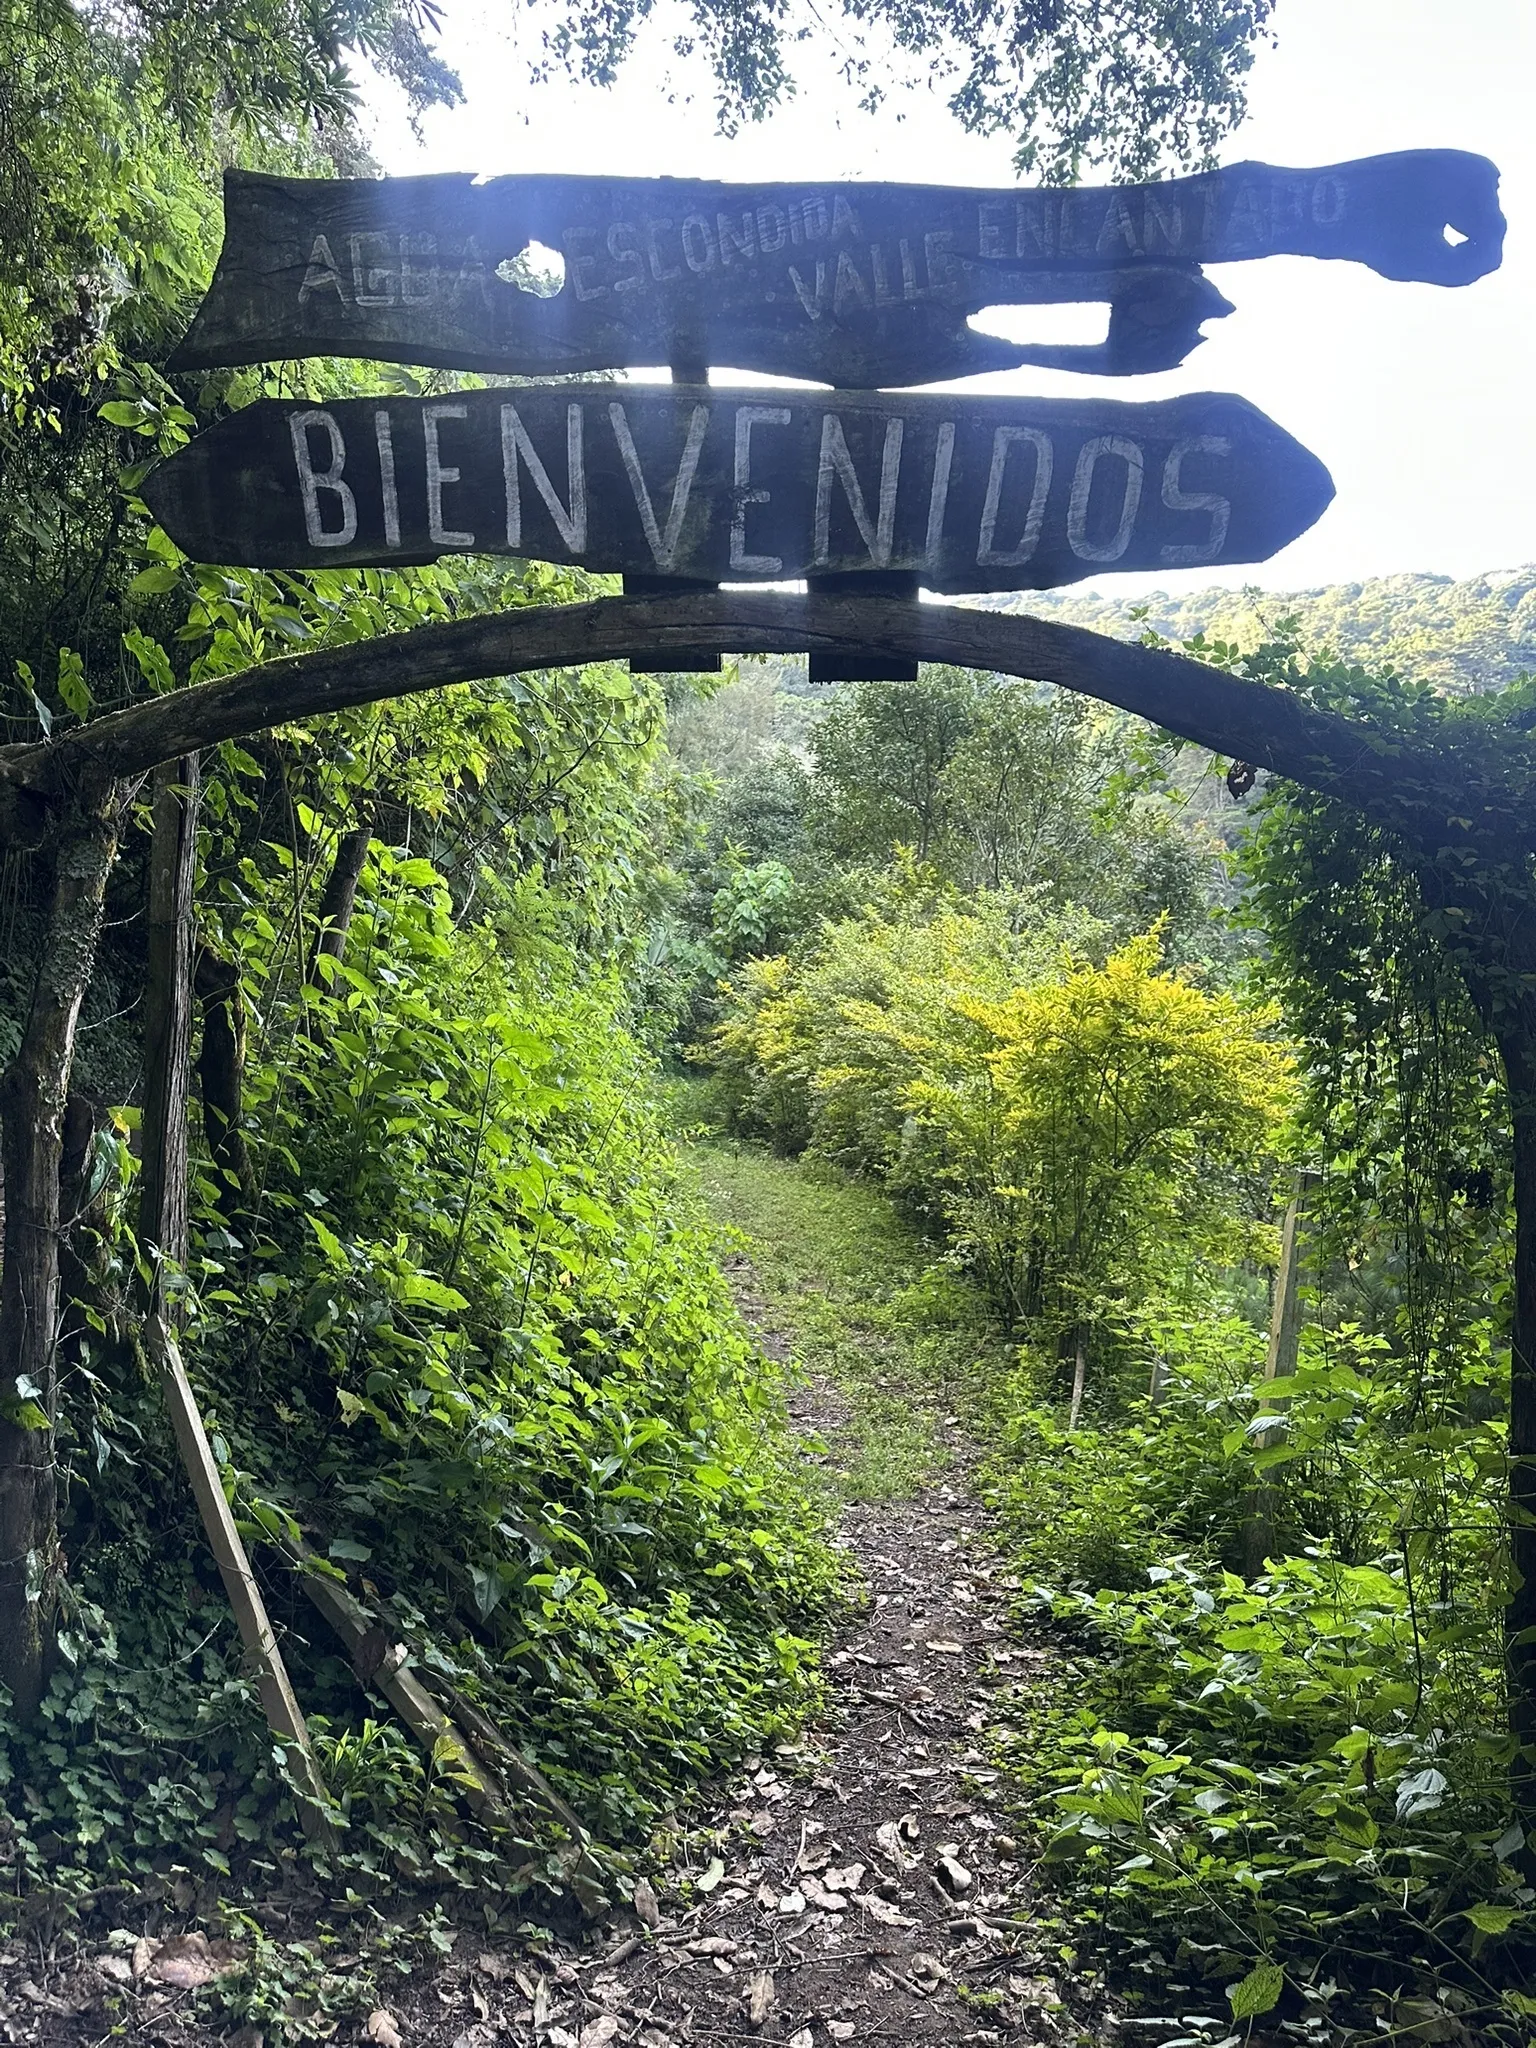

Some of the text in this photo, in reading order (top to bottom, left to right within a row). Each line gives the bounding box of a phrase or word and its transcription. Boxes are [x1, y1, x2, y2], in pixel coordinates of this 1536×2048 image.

[562, 194, 864, 301] ESCONDIDA
[788, 230, 957, 321] VALLE
[287, 402, 1233, 574] BIENVENIDOS
